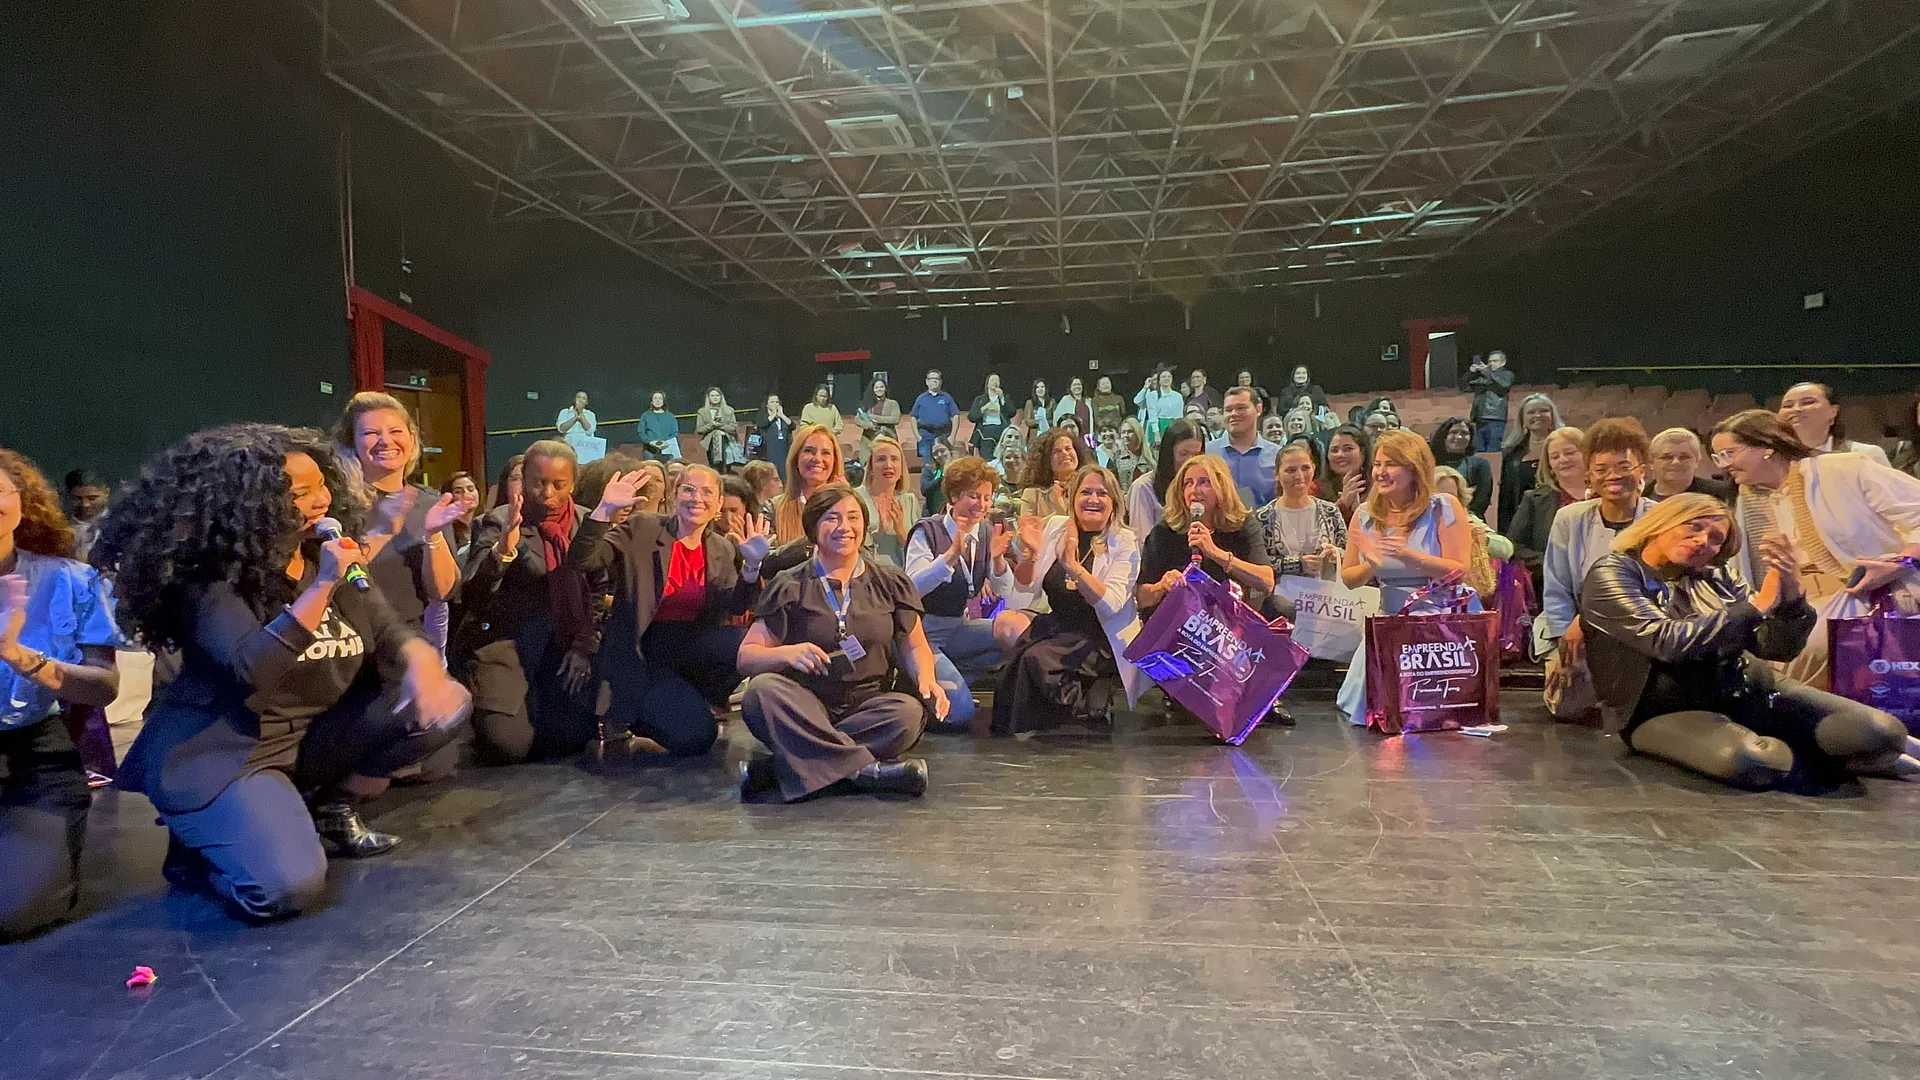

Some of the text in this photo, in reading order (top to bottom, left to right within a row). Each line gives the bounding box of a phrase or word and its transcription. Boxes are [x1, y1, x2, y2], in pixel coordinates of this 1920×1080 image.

[1298, 591, 1355, 607] EMPREENDA
[1295, 599, 1357, 621] BRASIL
[1197, 609, 1253, 657] EMPREENDA
[1401, 642, 1465, 654] EMPREENDA
[1399, 651, 1471, 670] BRASIL
